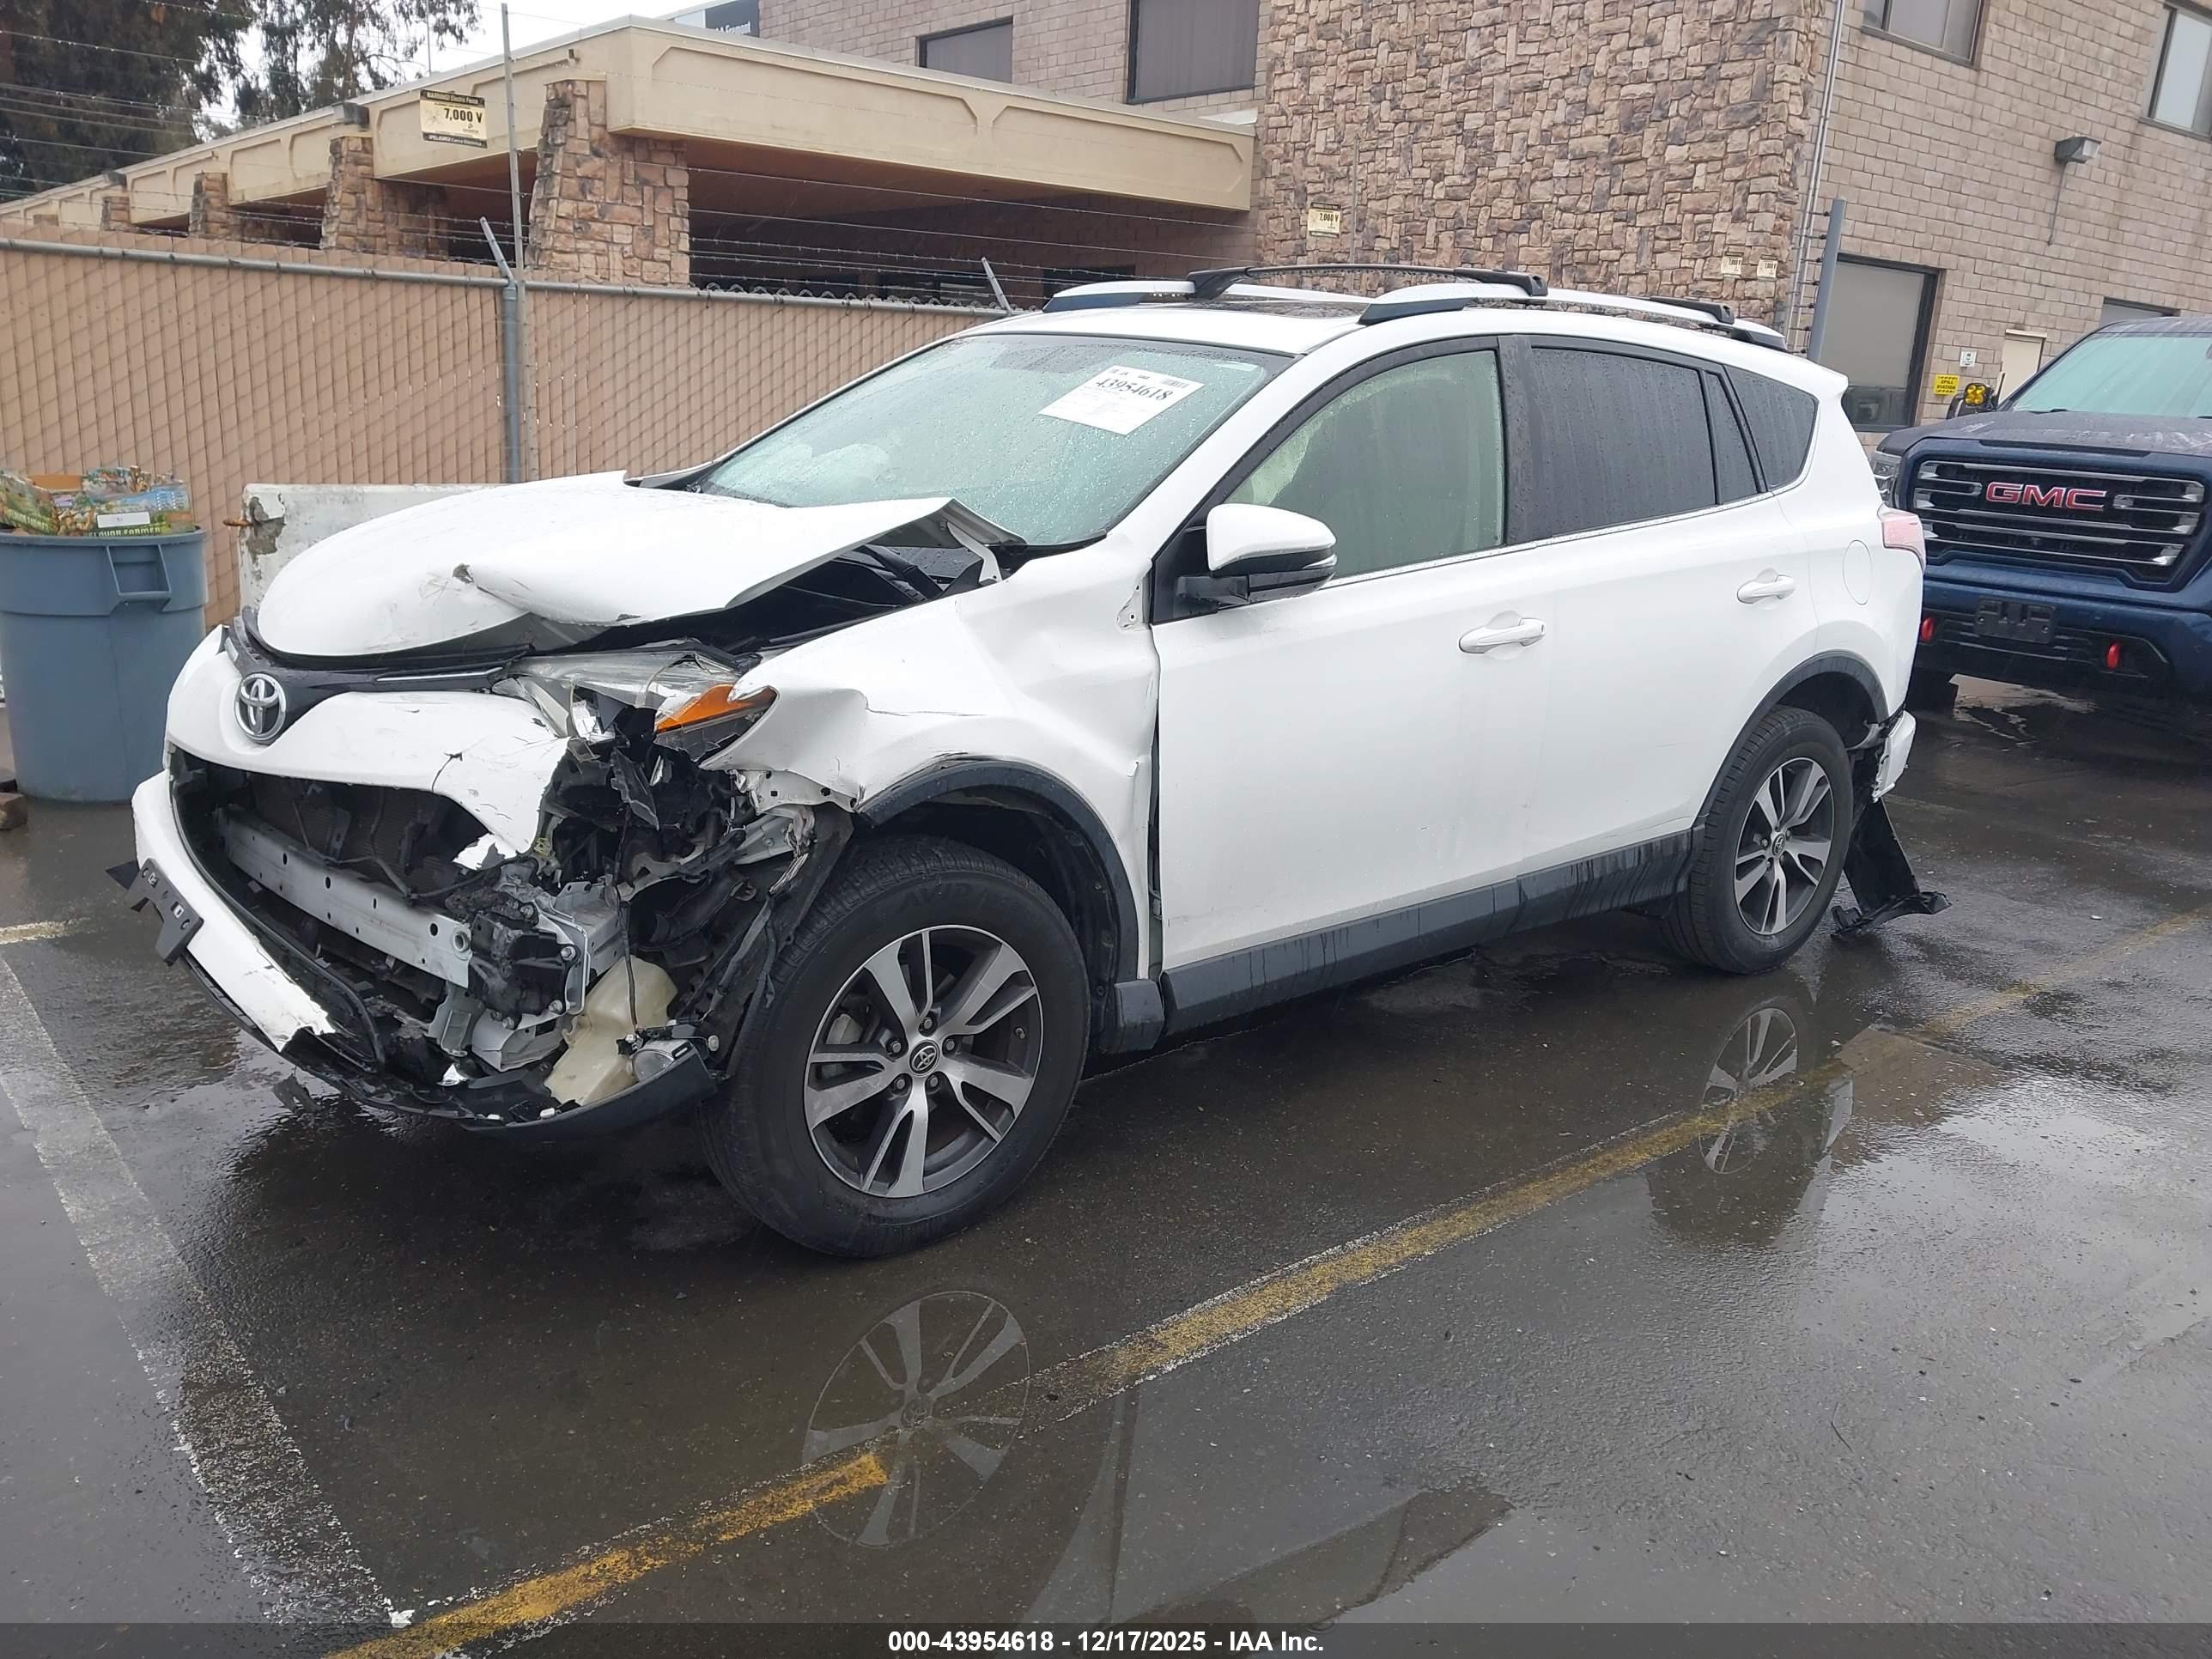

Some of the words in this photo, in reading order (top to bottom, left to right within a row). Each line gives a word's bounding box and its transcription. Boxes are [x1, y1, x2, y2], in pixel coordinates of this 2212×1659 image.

[444, 107, 473, 123] 7,000
[476, 112, 483, 124] V
[1334, 214, 1340, 222] V
[1095, 378, 1174, 401] 43954618
[1986, 481, 2107, 512] GMC
